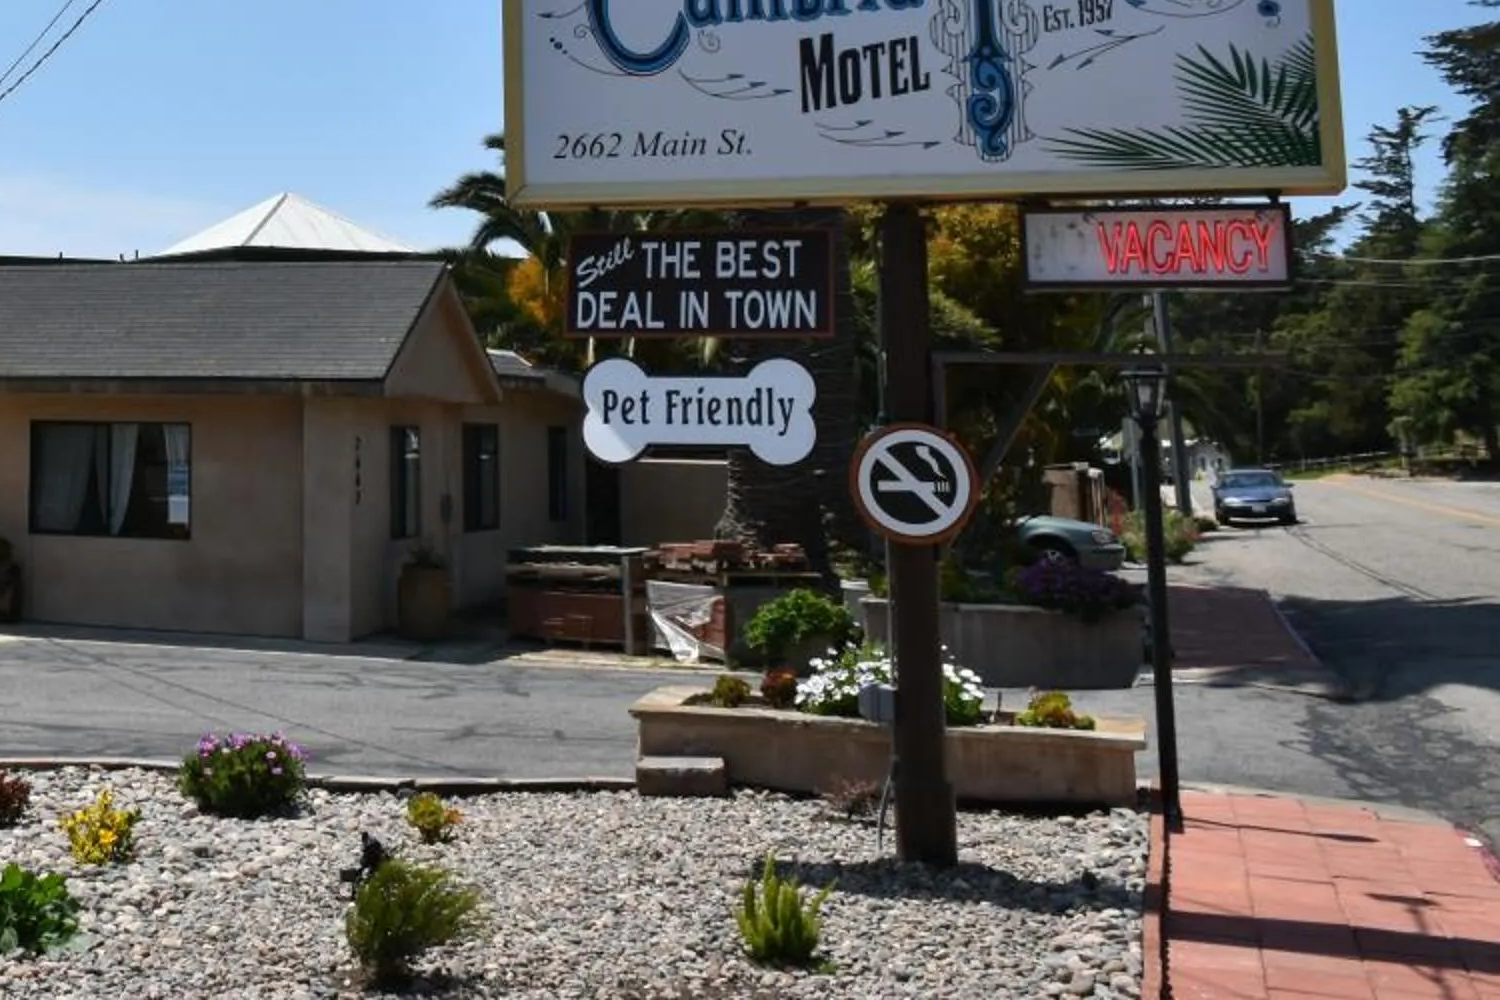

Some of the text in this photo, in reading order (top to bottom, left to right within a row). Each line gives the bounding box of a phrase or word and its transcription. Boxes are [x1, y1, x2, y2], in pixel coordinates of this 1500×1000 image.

[799, 33, 931, 113] MOTEL
[553, 128, 753, 159] 2662 Main St.
[576, 236, 803, 288] Still THE BEST
[1097, 217, 1276, 274] VACANCY
[576, 289, 817, 329] DEAL IN TOWN
[602, 386, 795, 436] Pet Friendly
